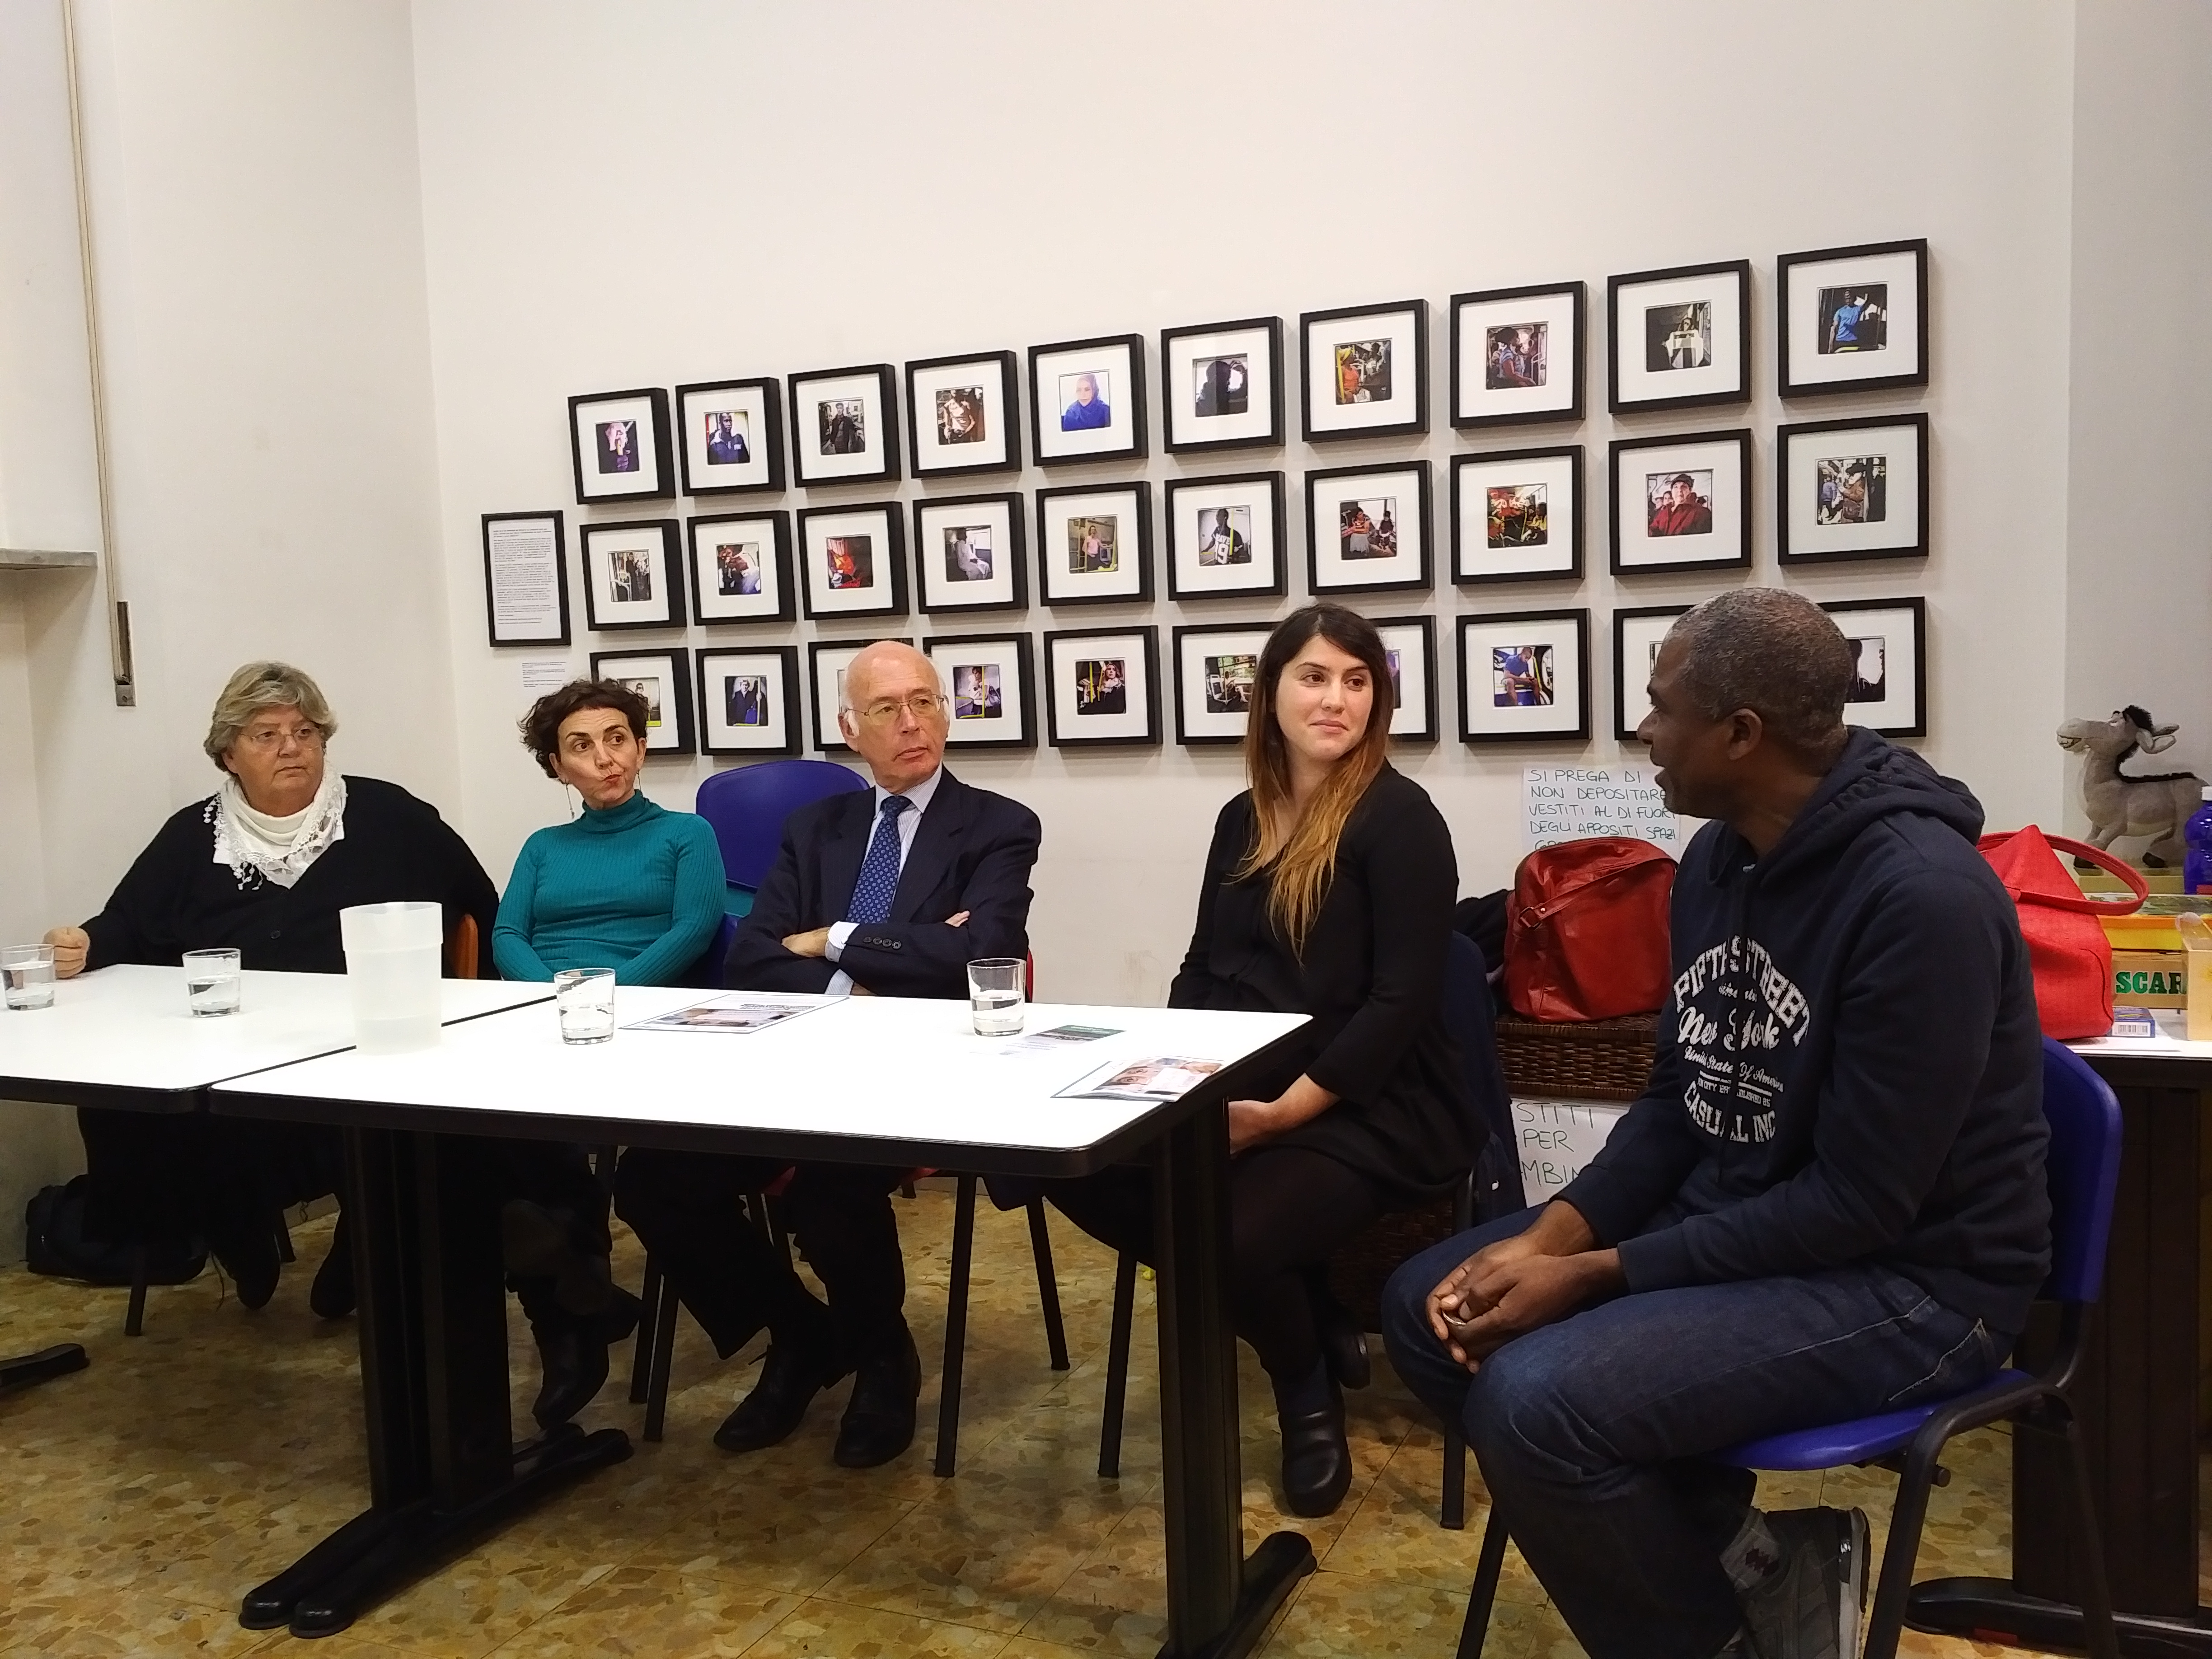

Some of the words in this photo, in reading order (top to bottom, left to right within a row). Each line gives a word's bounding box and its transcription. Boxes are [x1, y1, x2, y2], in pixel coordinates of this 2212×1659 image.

[1528, 769, 1547, 782] SI
[1555, 769, 1610, 783] PREGA
[1625, 770, 1640, 783] DI
[1531, 786, 1564, 799] NON
[1577, 787, 1666, 801] DEPOSITARE
[1529, 803, 1584, 816] VESTITI
[1594, 805, 1612, 818] AL
[1618, 806, 1631, 819] DI
[1578, 822, 1638, 837] APPOSITI
[1646, 826, 1676, 839] SPAZI
[1516, 1102, 1593, 1129] STITI
[1523, 1128, 1575, 1152] PER
